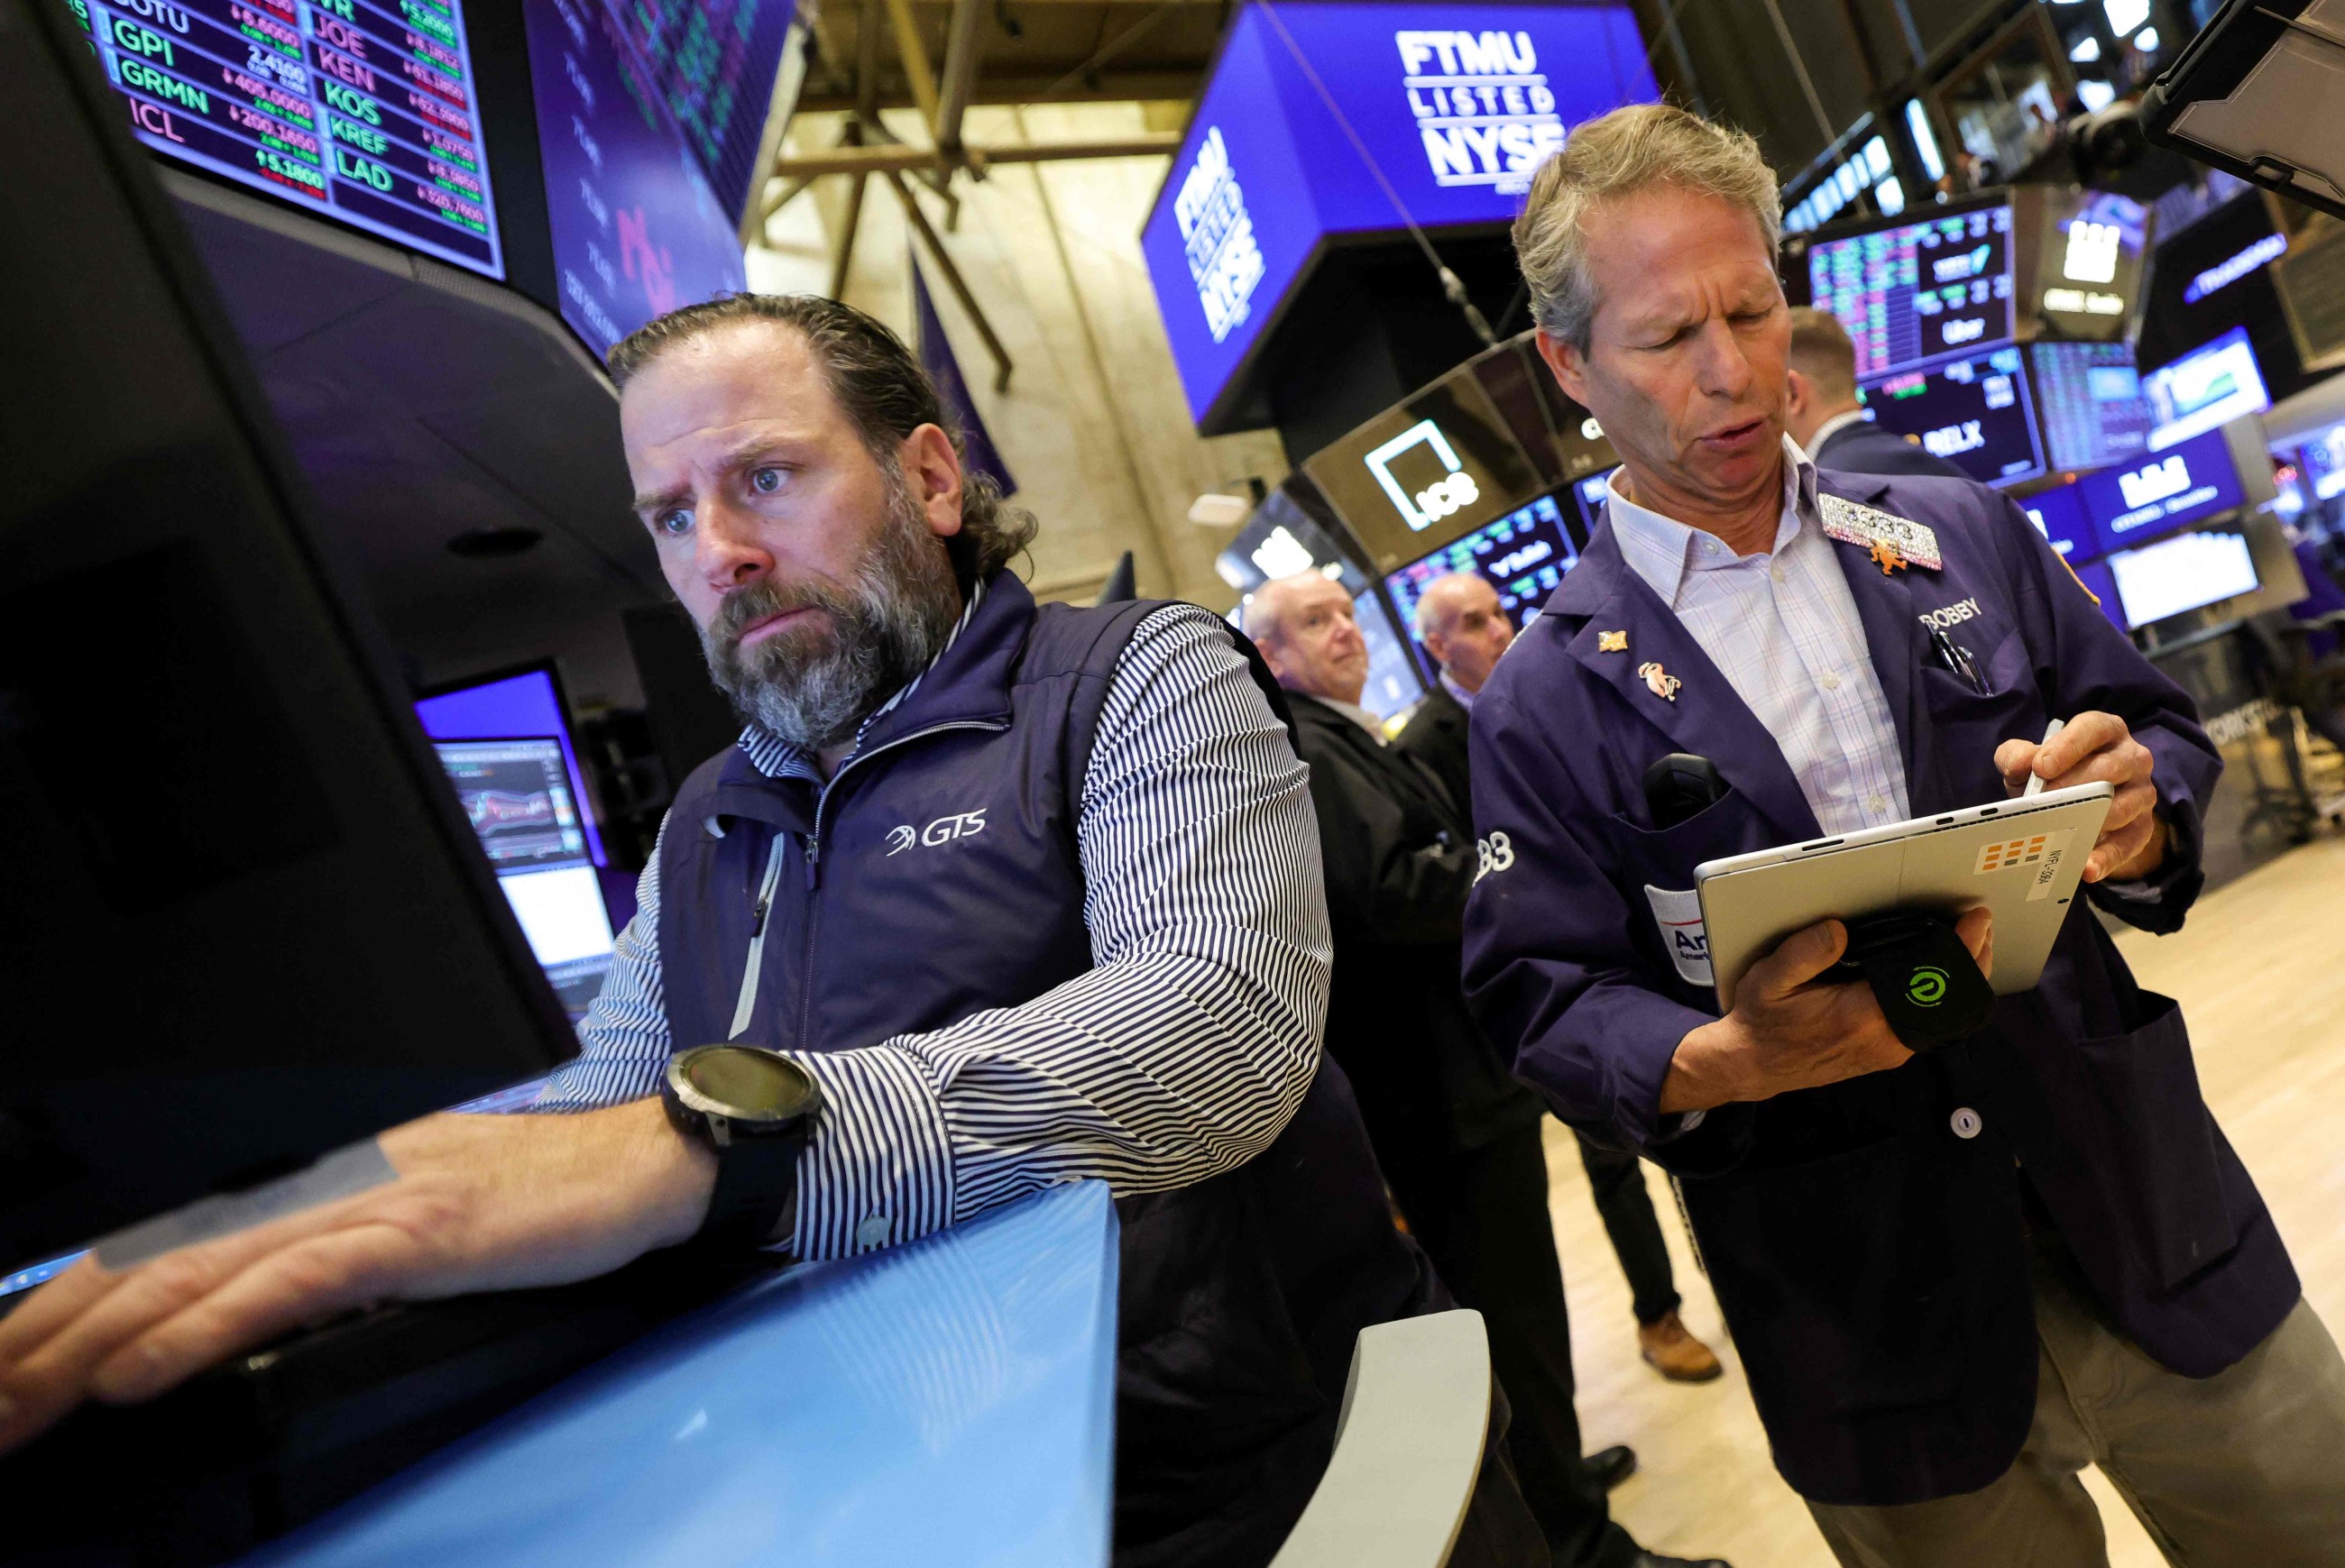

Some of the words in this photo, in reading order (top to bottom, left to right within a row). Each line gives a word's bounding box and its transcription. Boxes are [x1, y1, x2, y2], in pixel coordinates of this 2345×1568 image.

[115, 19, 175, 67] GPI
[315, 14, 368, 60] JOE
[1395, 31, 1537, 76] FTMU
[121, 59, 210, 115] GRMN
[317, 46, 376, 94] KEN
[129, 96, 186, 142] ICL
[324, 79, 382, 126] KOS
[1407, 86, 1556, 118] LISTED
[329, 115, 390, 156] KREF
[1421, 123, 1566, 178] NYSE
[336, 149, 394, 193] LAD
[1918, 597, 1982, 630] BOBBY
[922, 808, 988, 847] GTS
